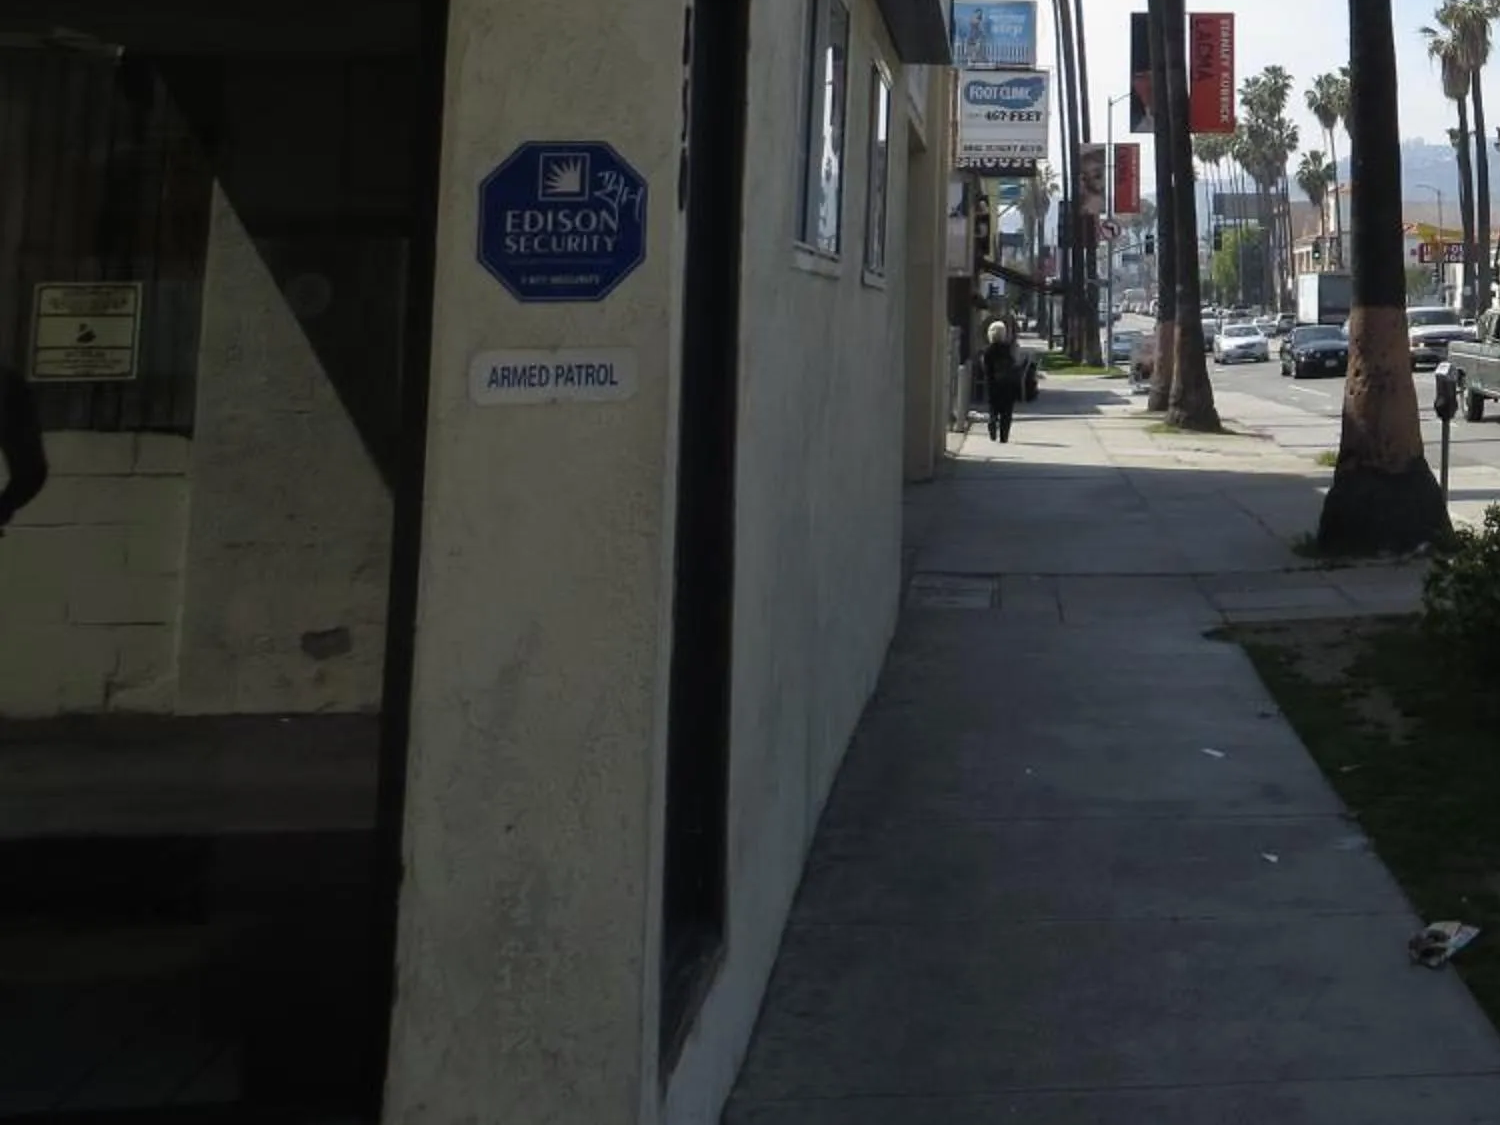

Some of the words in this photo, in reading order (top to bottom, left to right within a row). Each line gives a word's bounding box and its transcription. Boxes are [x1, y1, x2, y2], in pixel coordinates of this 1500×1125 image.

[969, 85, 998, 100] FOOT
[1000, 86, 1032, 100] CLINIC
[1219, 72, 1233, 124] KUBRICK
[504, 208, 618, 234] EDISON
[504, 234, 617, 255] SECURITY
[487, 364, 550, 388] ARMED
[554, 362, 619, 387] PATROL
